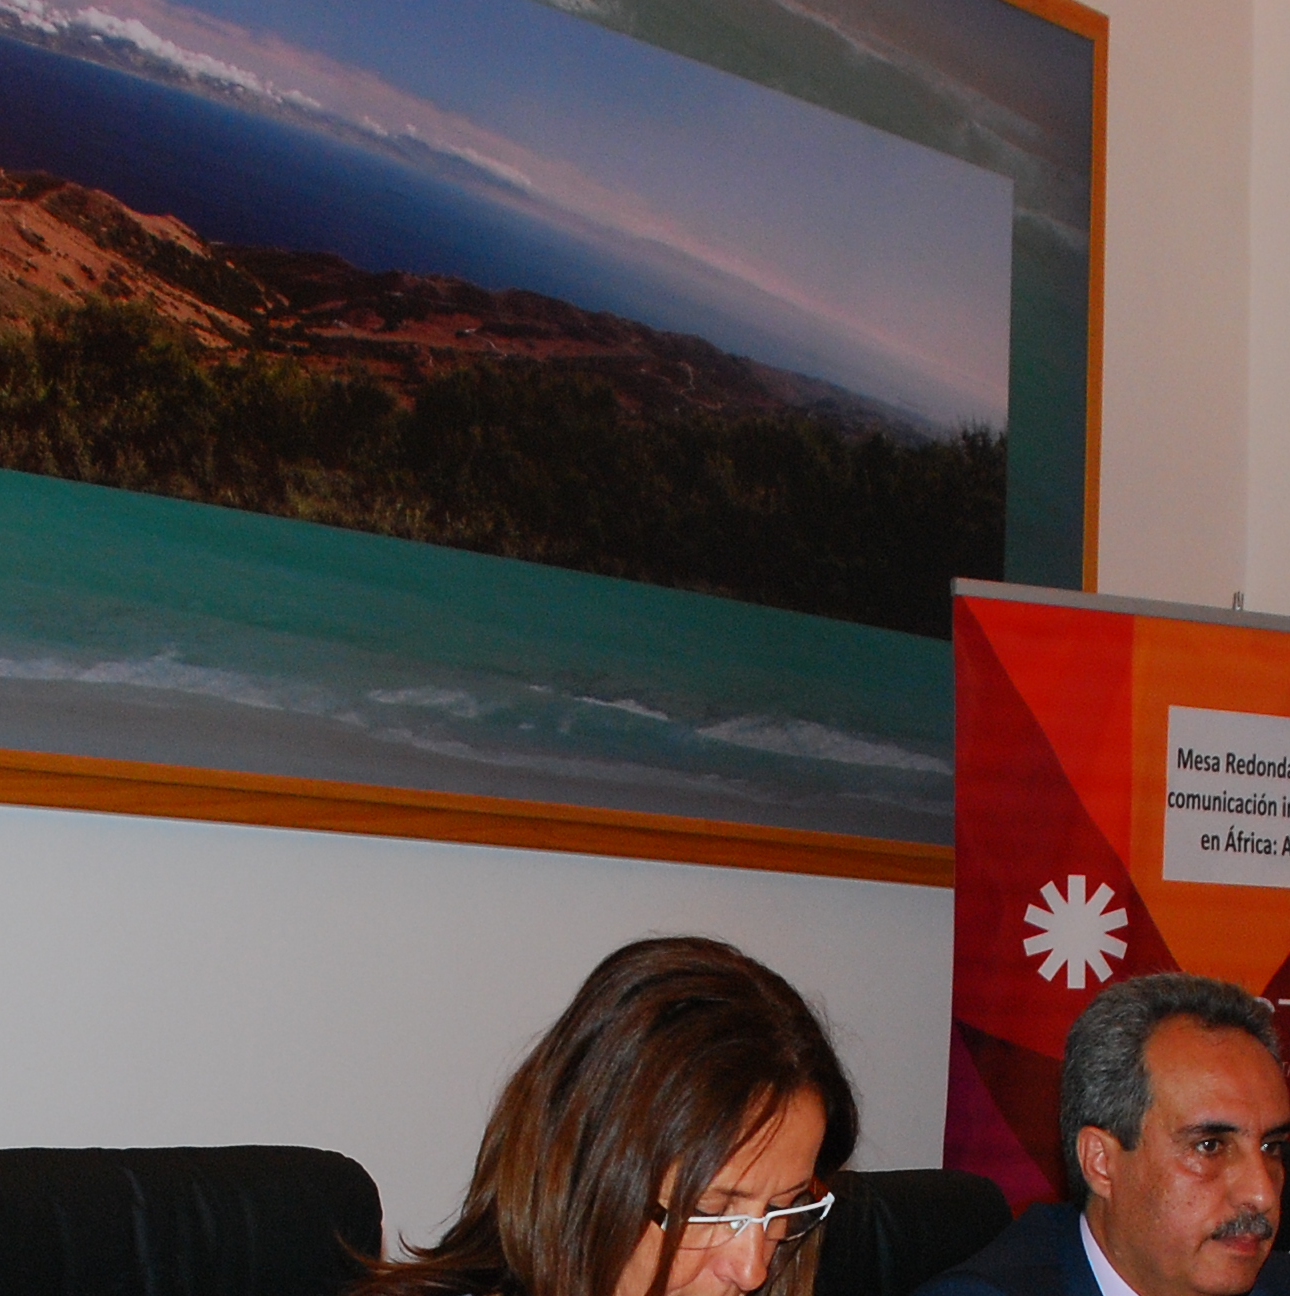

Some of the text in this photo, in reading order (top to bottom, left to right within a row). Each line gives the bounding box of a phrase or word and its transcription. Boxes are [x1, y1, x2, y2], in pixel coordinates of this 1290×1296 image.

[1177, 747, 1220, 773] Mesa
[1167, 790, 1277, 817] comunicación
[1201, 833, 1220, 851] en
[1224, 824, 1277, 855] África:
